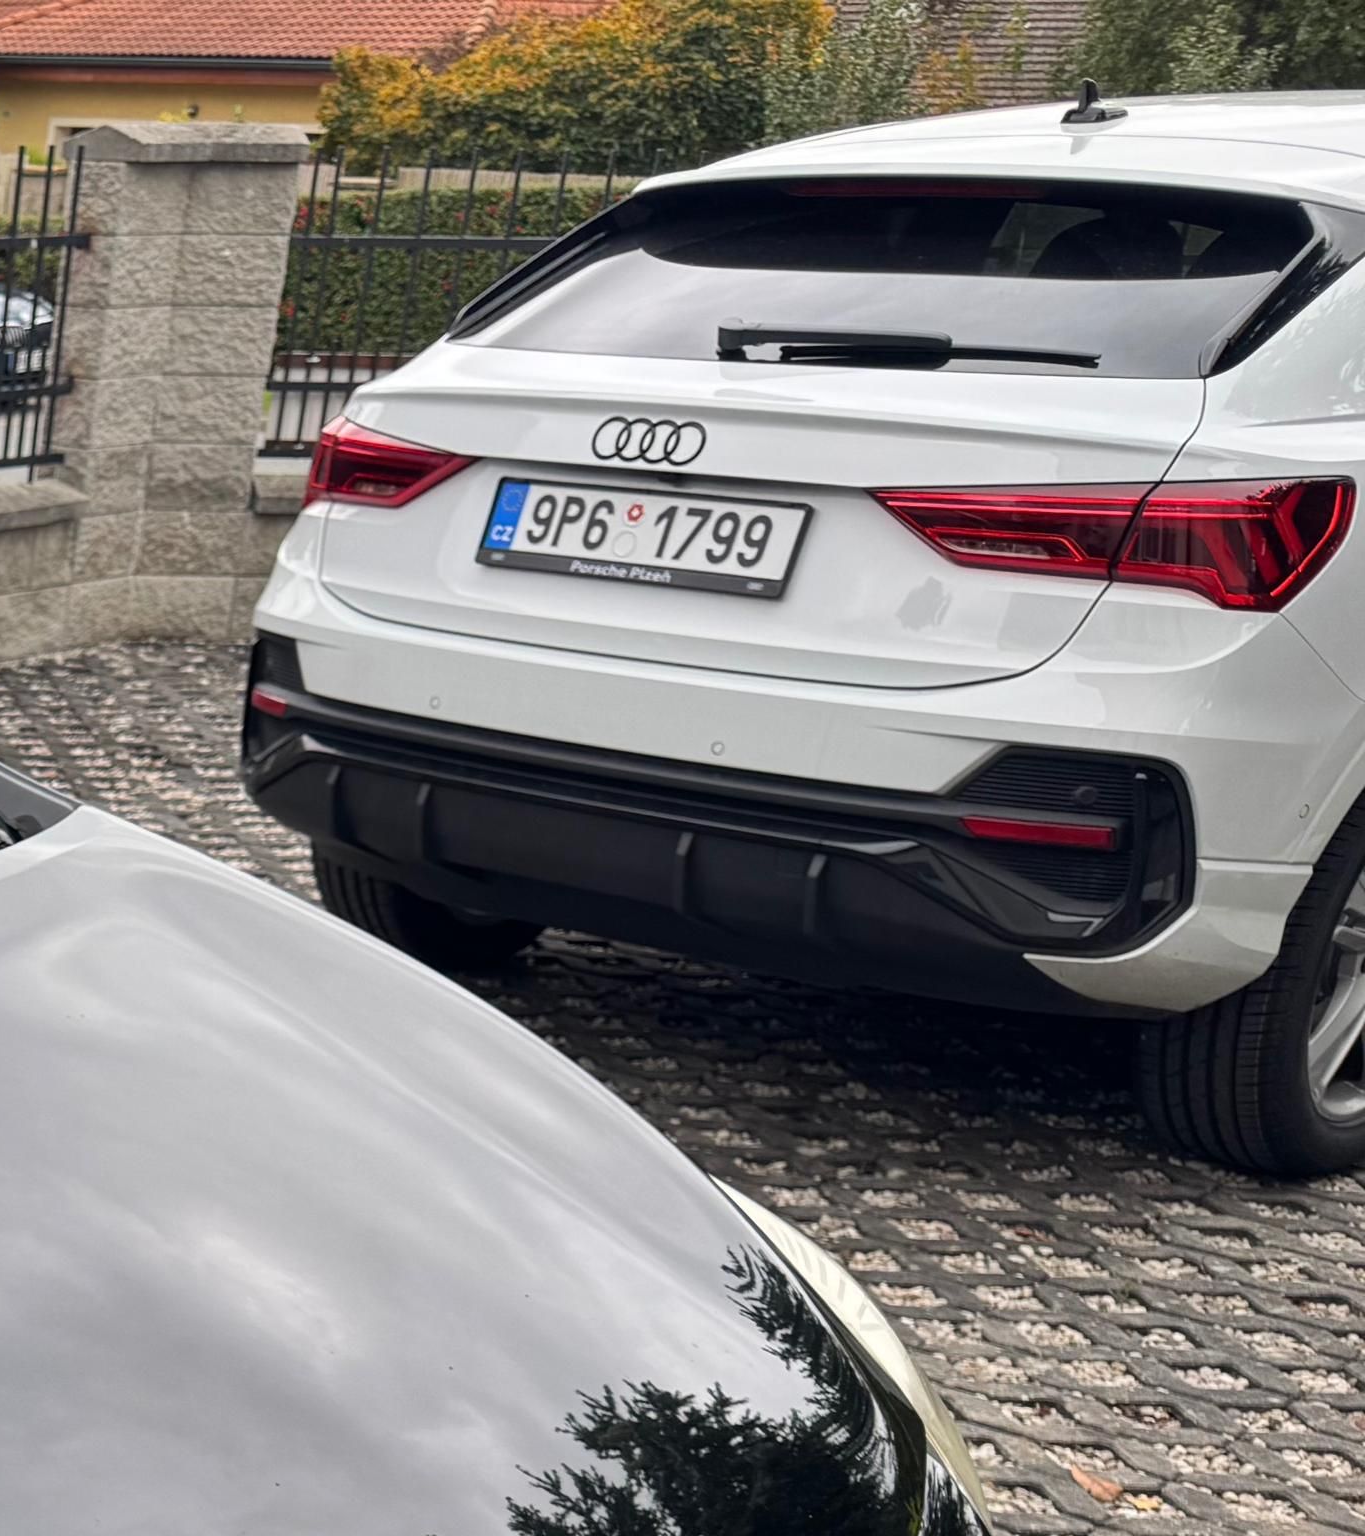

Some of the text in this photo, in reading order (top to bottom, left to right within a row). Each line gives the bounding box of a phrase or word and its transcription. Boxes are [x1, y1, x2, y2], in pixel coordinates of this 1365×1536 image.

[490, 524, 514, 542] CZ
[526, 494, 773, 568] 9P6 1799
[569, 559, 628, 578] Porsche
